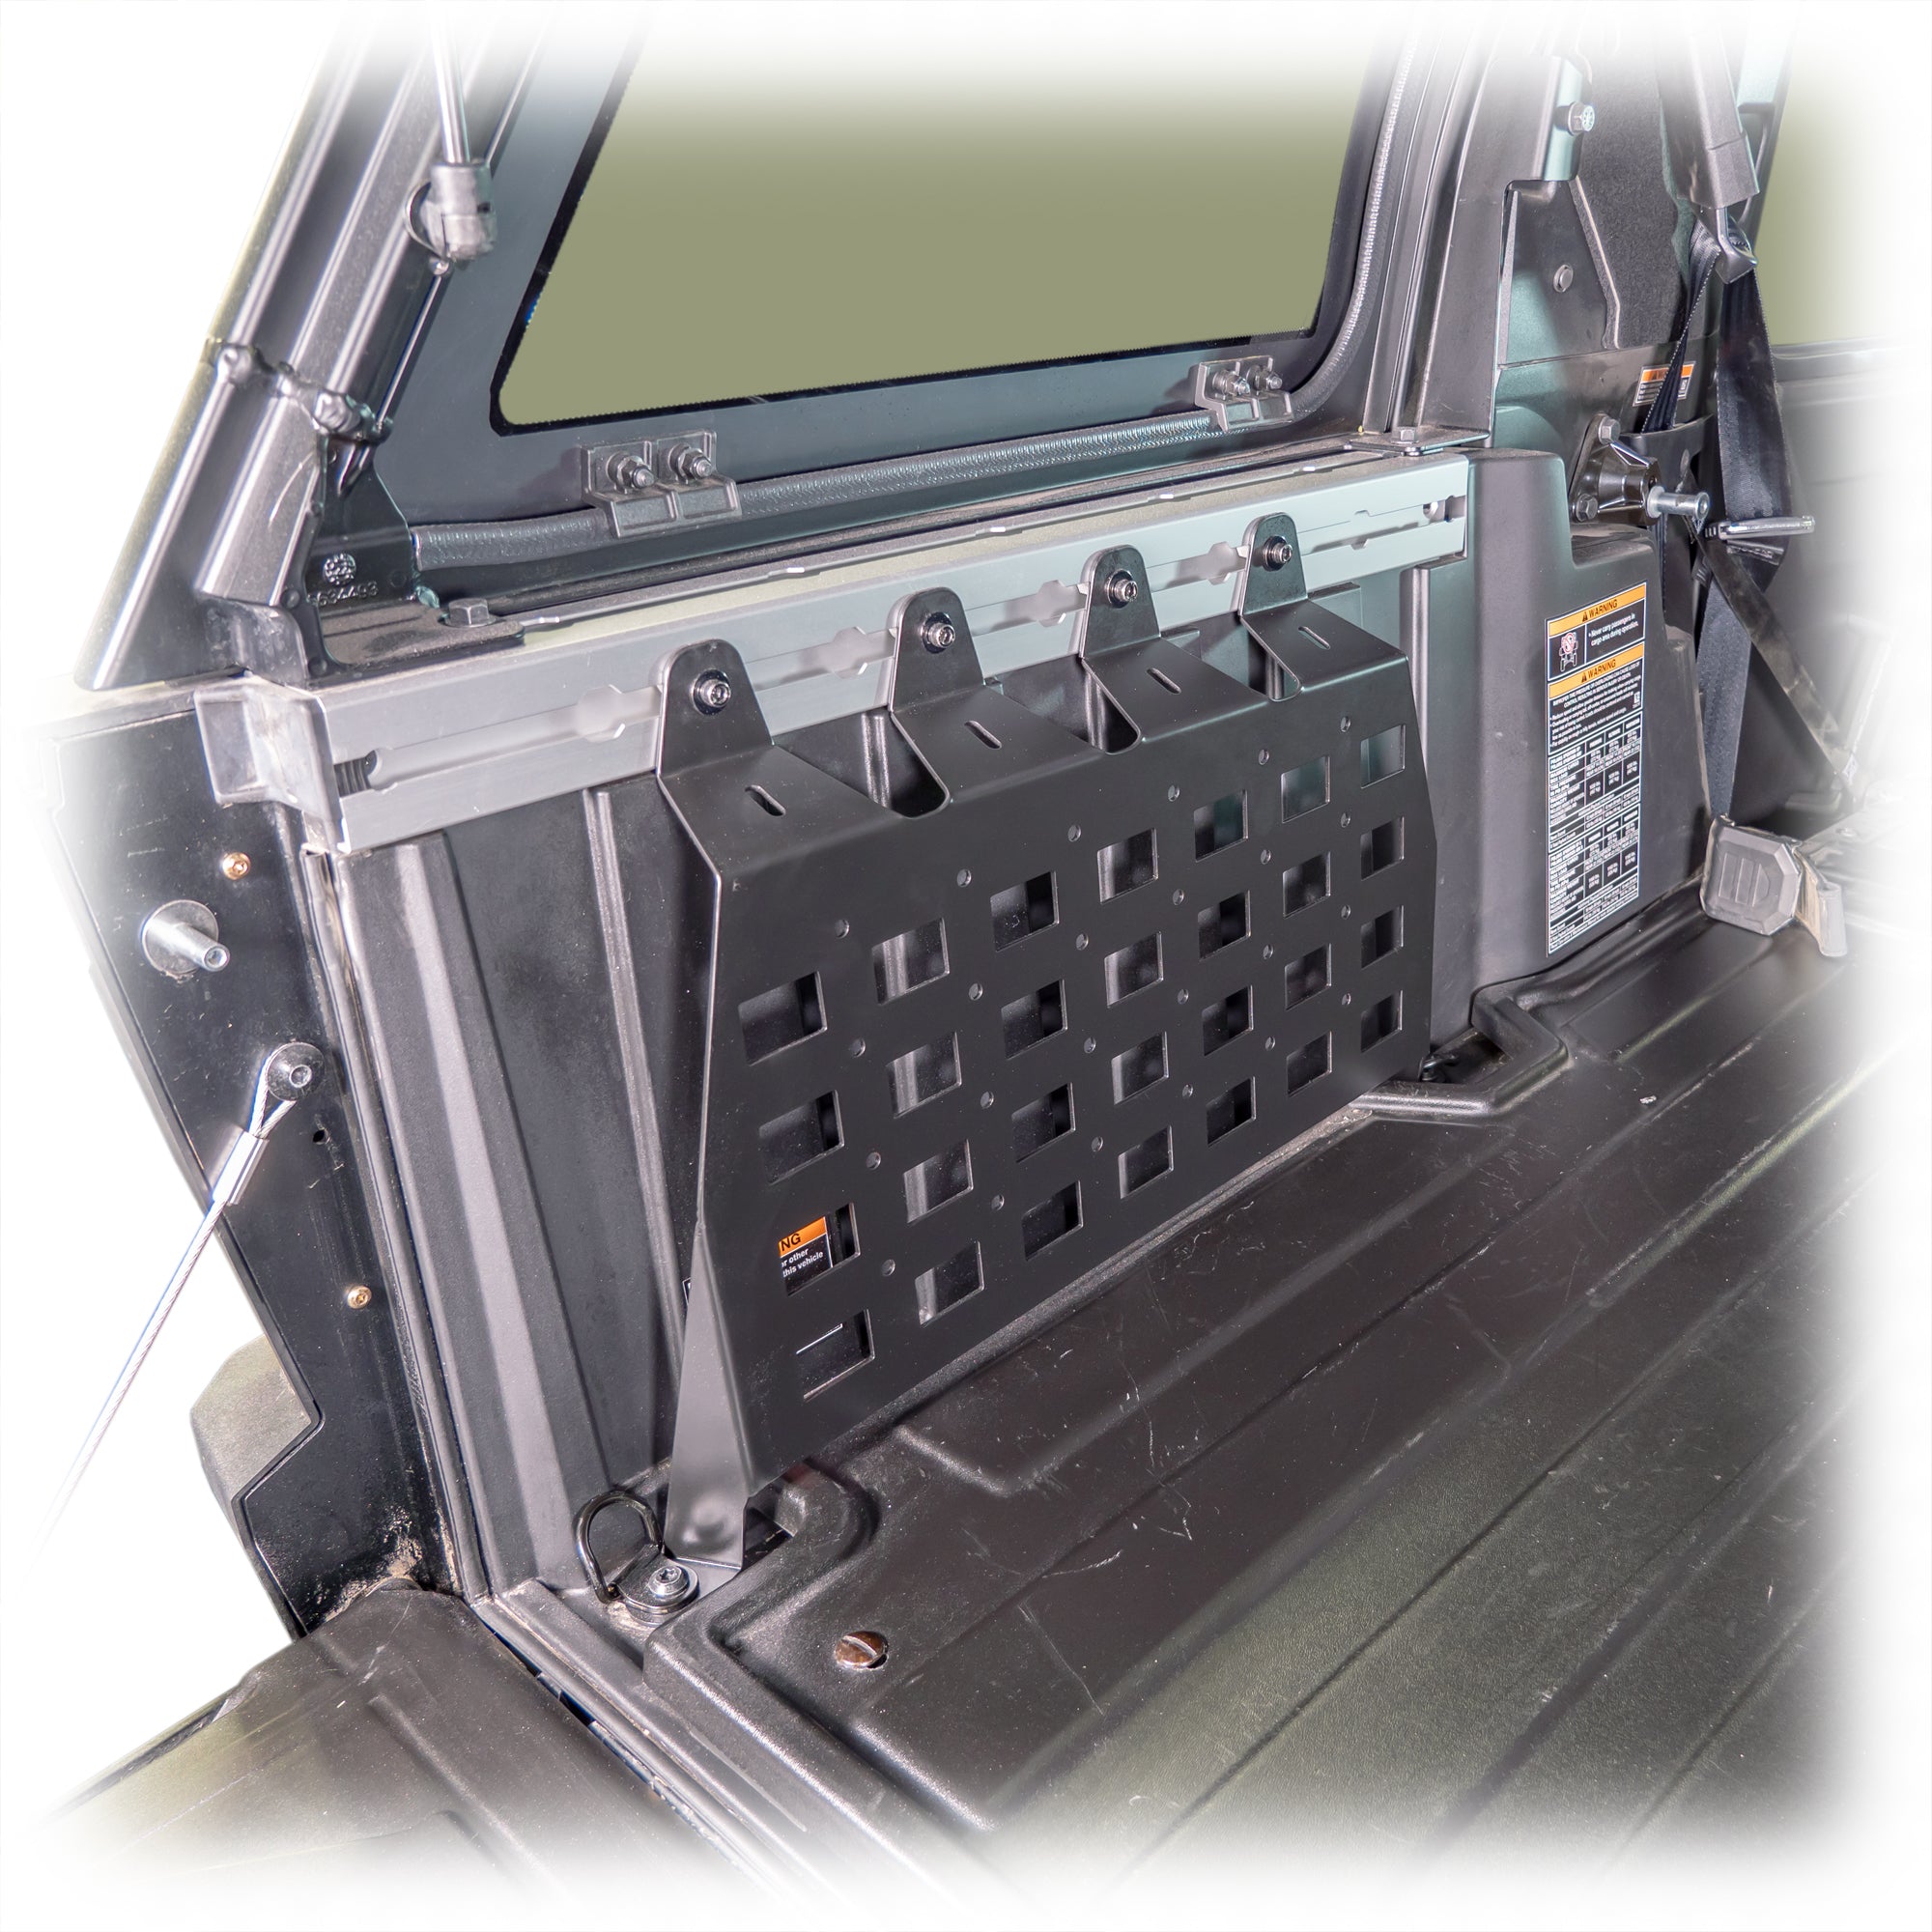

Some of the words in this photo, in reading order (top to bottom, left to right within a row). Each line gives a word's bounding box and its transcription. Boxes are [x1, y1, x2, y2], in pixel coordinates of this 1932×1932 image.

[1588, 599, 1618, 618] WARNING
[1587, 659, 1616, 679] WARNING
[782, 1265, 797, 1278] this
[797, 1251, 824, 1269] vehicle
[788, 1248, 810, 1264] other
